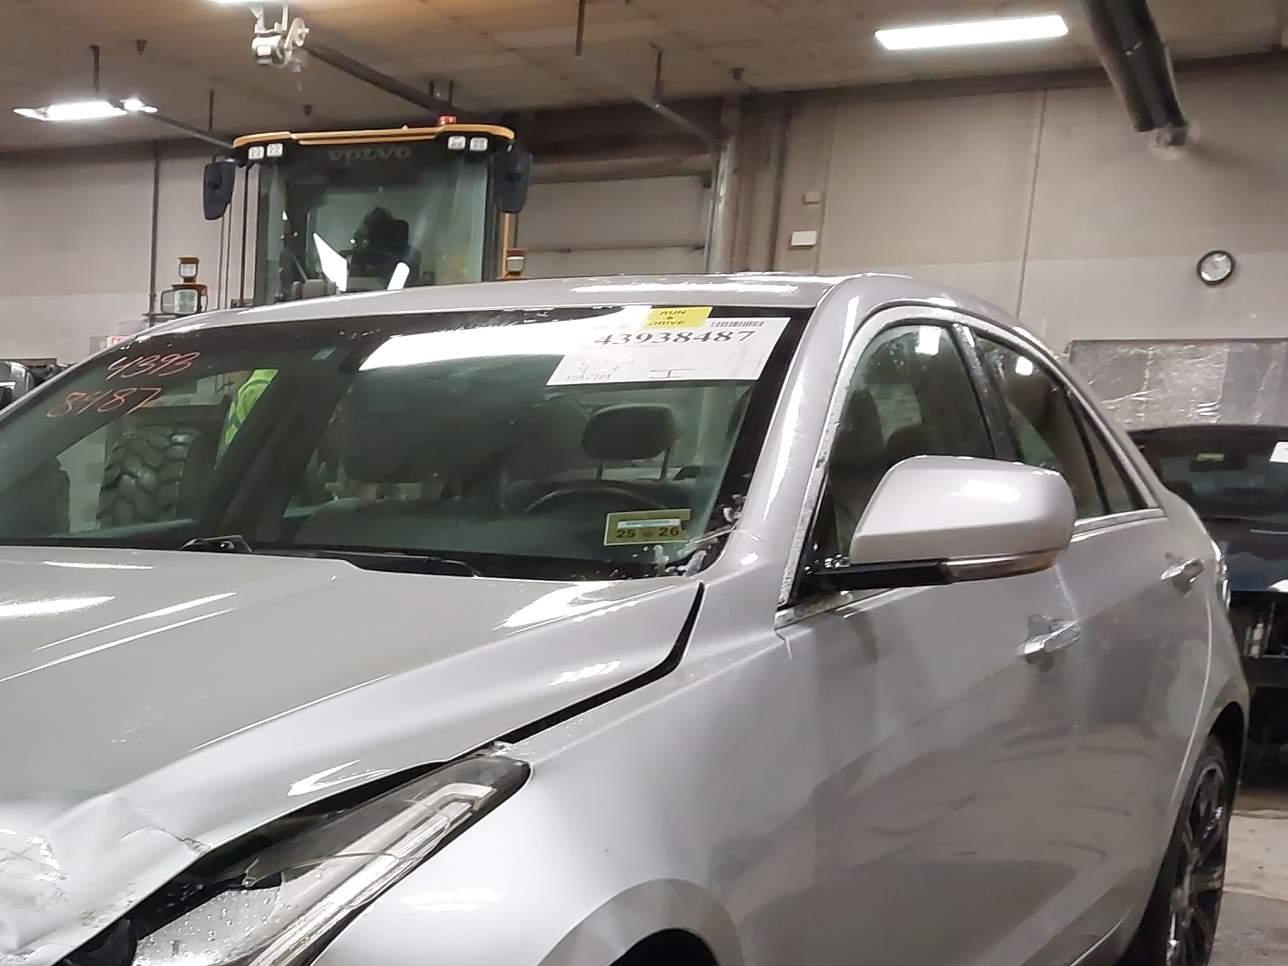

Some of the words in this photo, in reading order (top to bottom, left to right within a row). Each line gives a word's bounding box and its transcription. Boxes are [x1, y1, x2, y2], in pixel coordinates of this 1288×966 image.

[594, 330, 756, 346] 43938487
[616, 528, 637, 539] 25
[658, 526, 681, 537] 26
